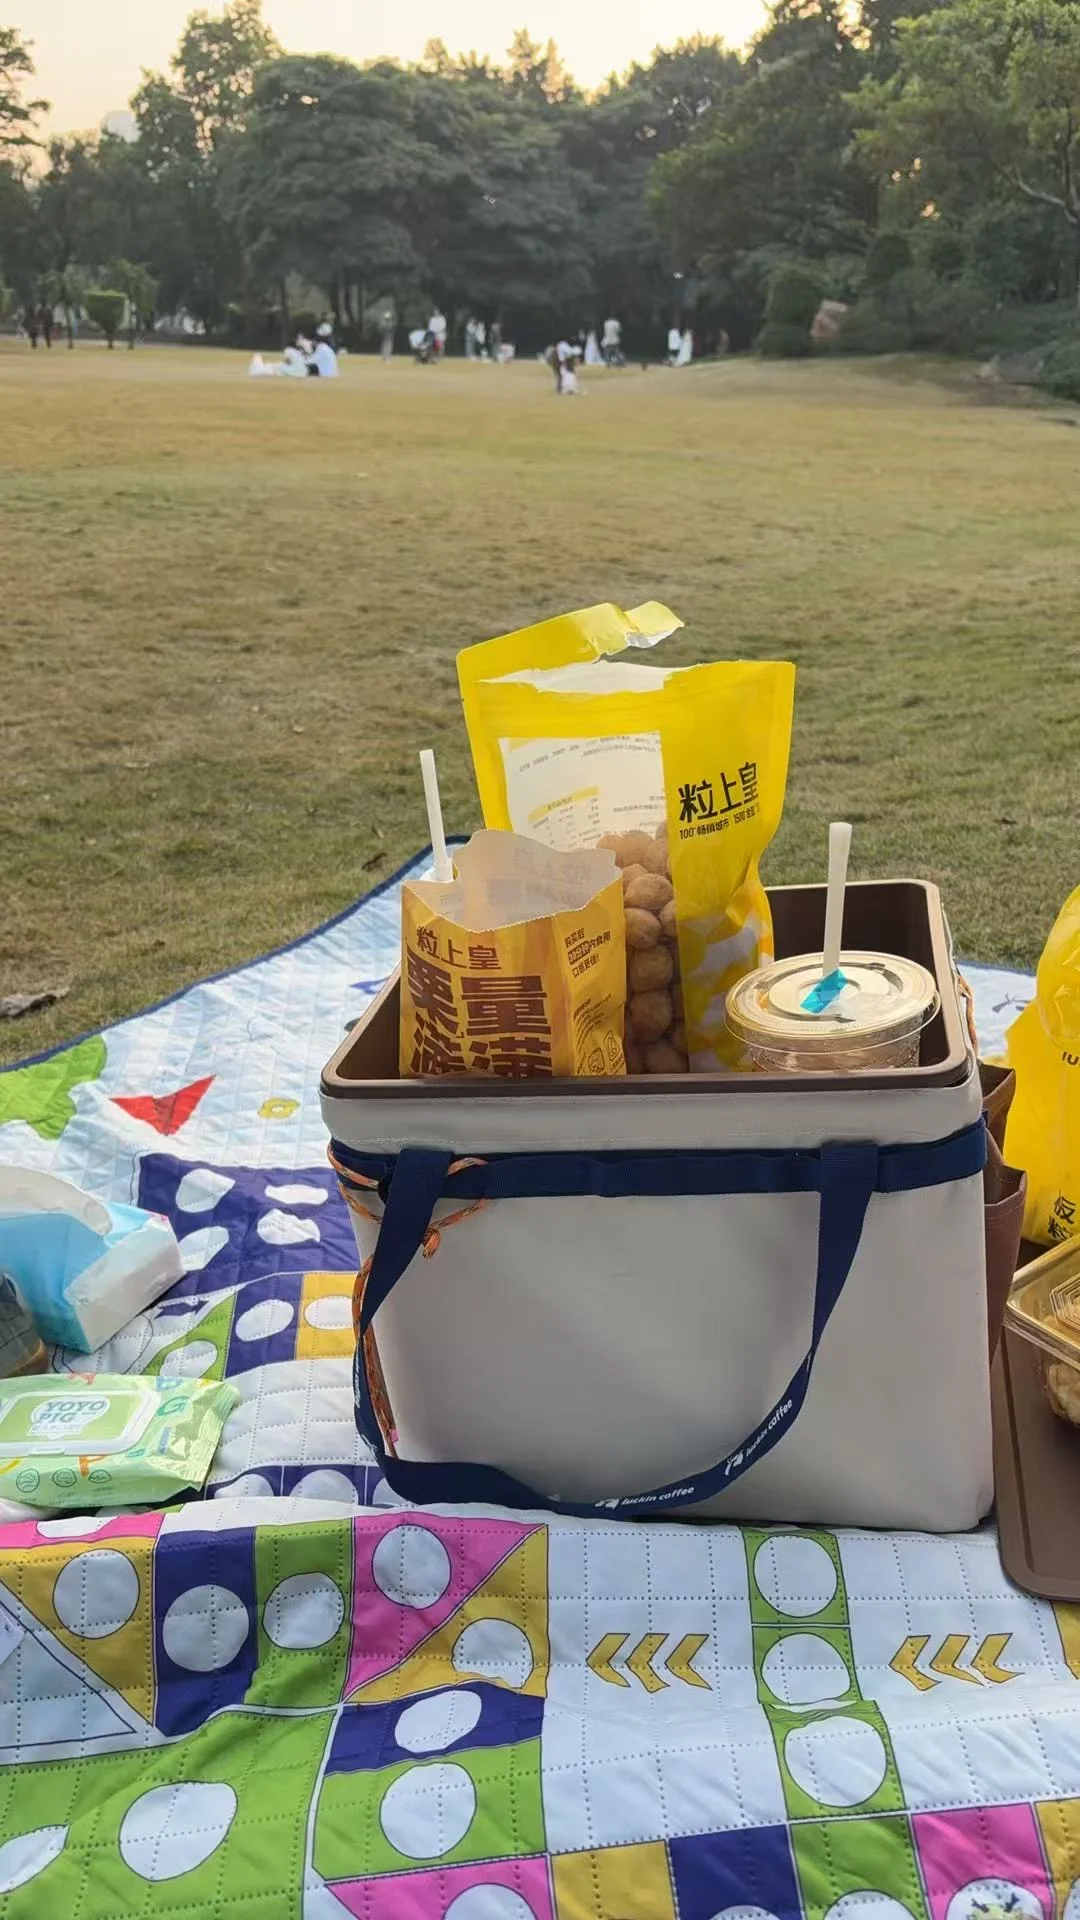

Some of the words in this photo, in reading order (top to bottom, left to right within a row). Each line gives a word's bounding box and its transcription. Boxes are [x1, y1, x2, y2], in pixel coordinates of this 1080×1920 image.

[678, 761, 759, 824] 粒上皇
[416, 925, 502, 970] 粒上皇
[407, 949, 552, 1035] 栗量
[39, 1412, 77, 1423] PIG
[47, 1400, 105, 1412] YOYO
[768, 1399, 793, 1430] coffee
[621, 1496, 657, 1506] luckin
[659, 1487, 695, 1500] coffee
